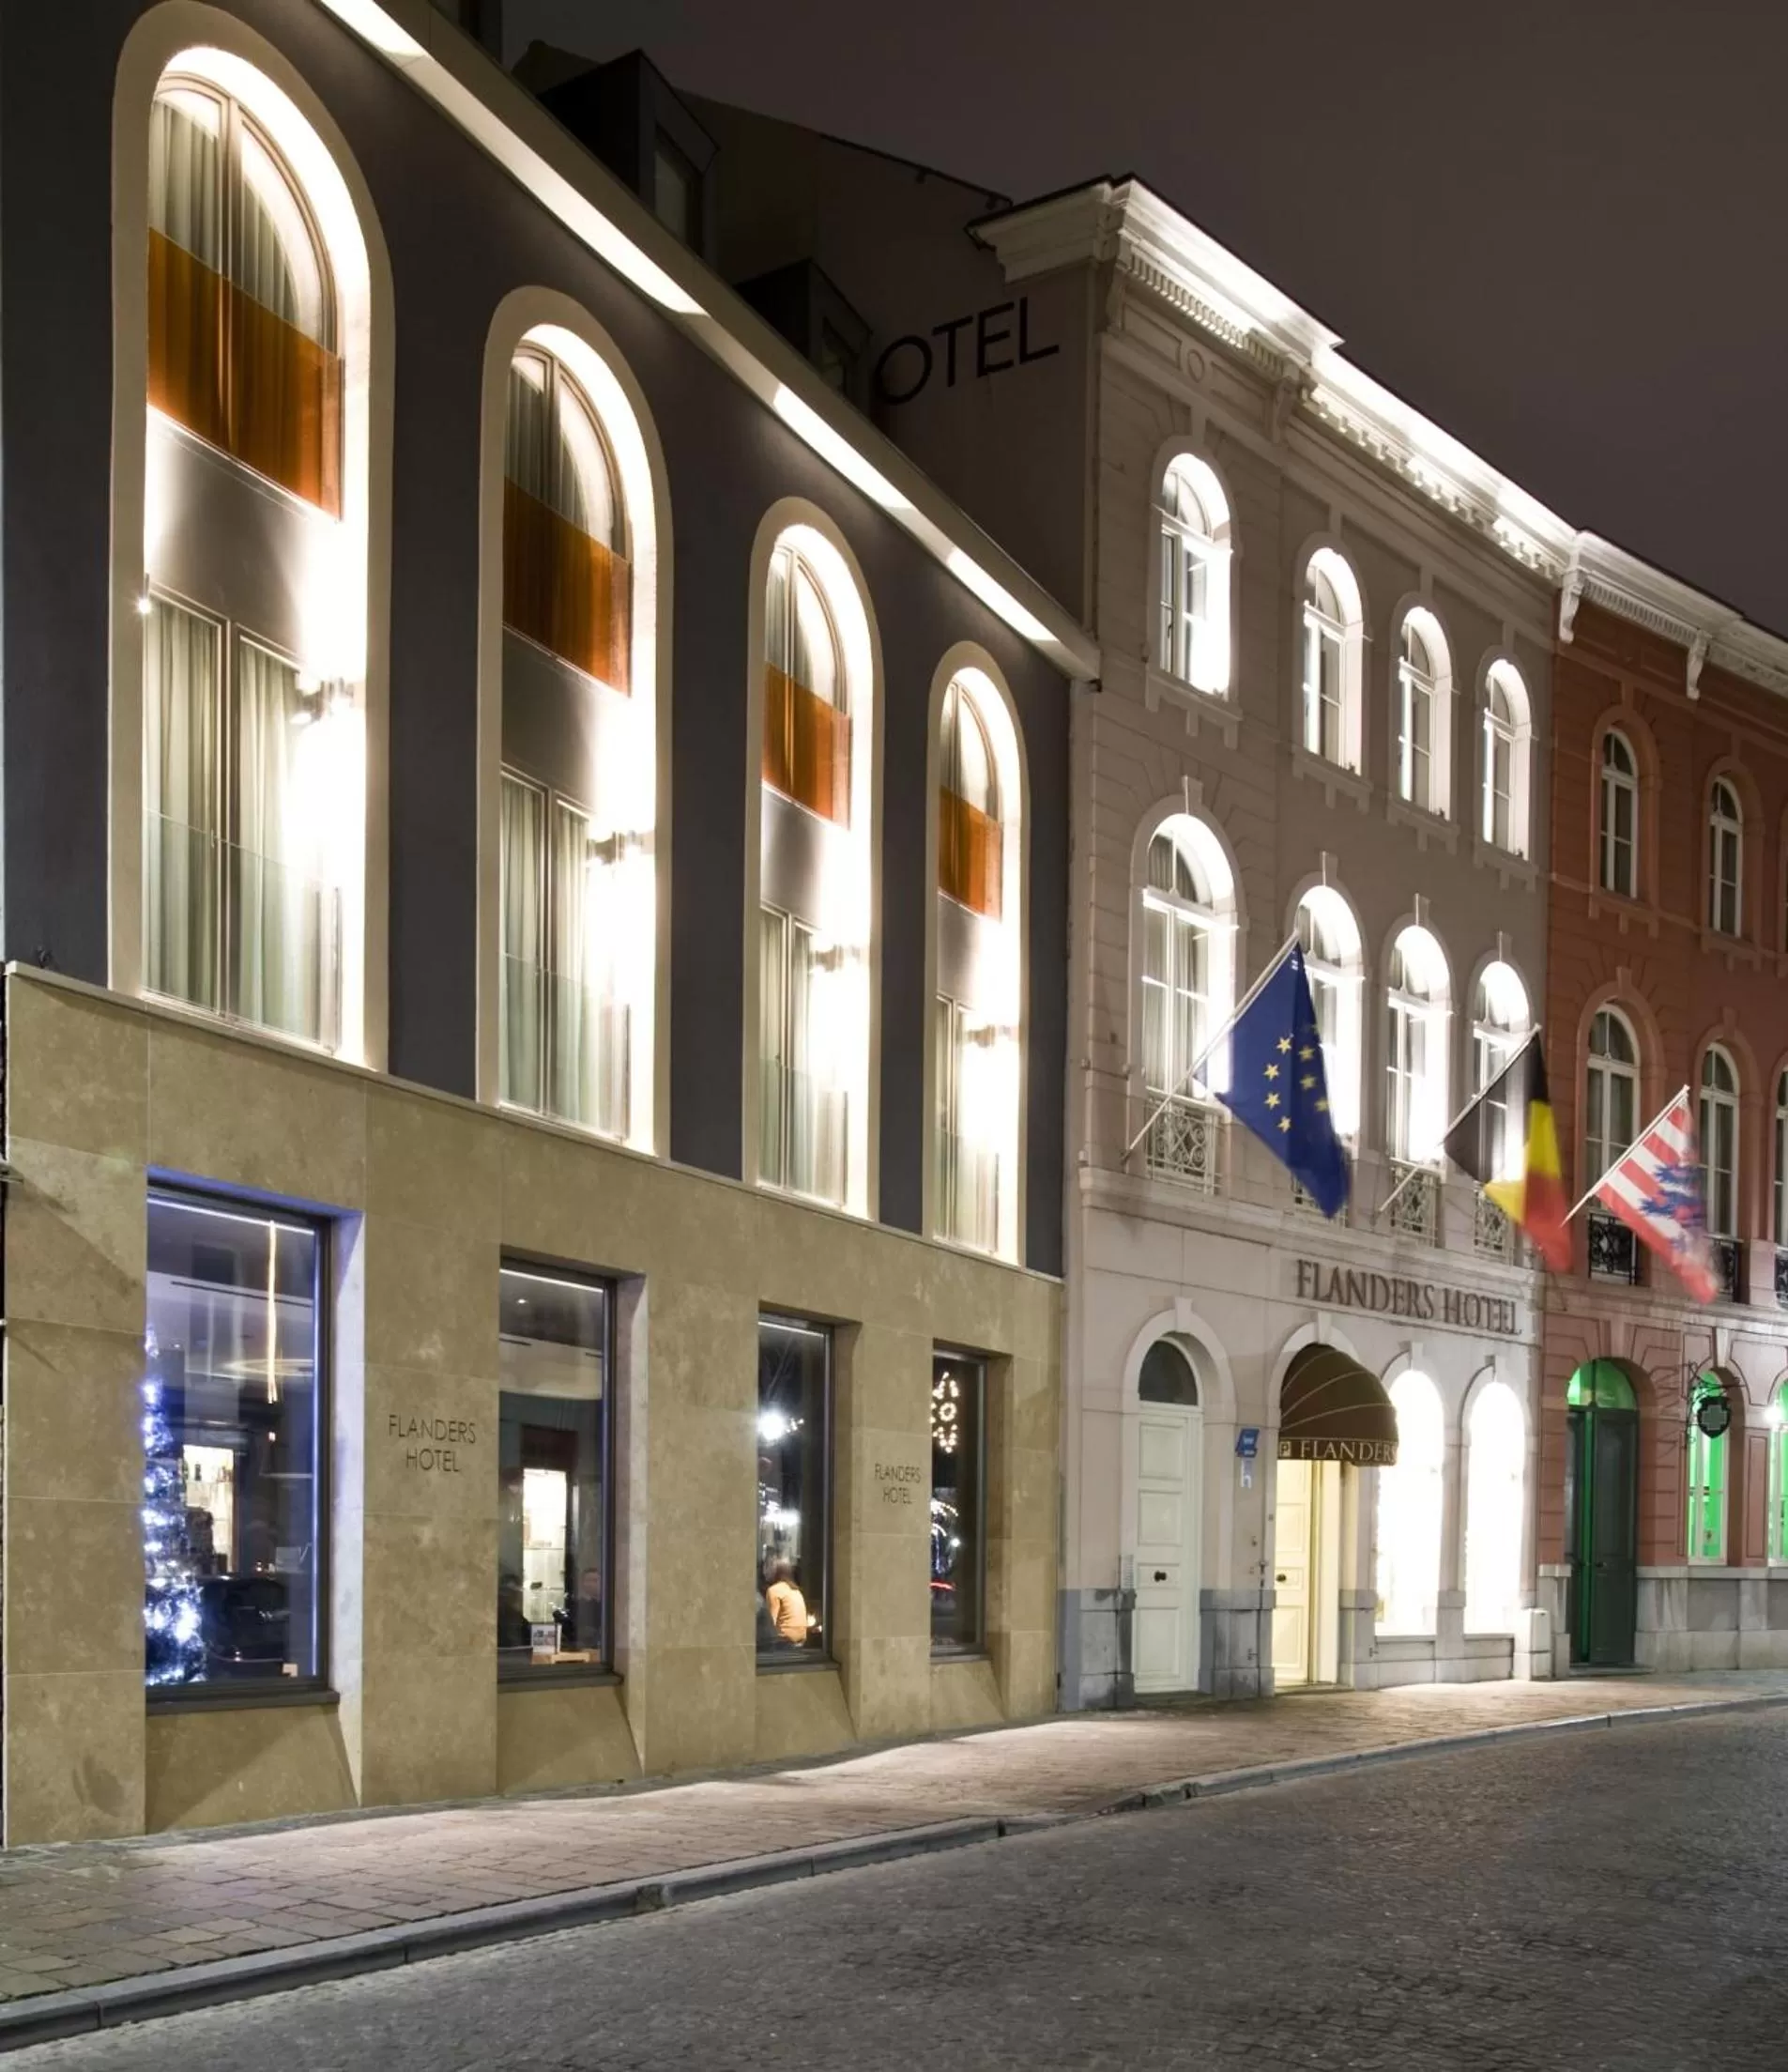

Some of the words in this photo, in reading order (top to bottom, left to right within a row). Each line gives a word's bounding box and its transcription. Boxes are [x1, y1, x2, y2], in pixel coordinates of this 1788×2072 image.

[873, 296, 1060, 406] OTEL
[1296, 1259, 1435, 1319] FLANDERS
[1444, 1287, 1522, 1335] HOTEL
[389, 1413, 476, 1444] FLANDERS
[405, 1448, 460, 1472] HOTEL
[1300, 1441, 1398, 1463] FLANDERS
[874, 1463, 922, 1483] FLANDERS
[882, 1486, 912, 1504] HOTEL
